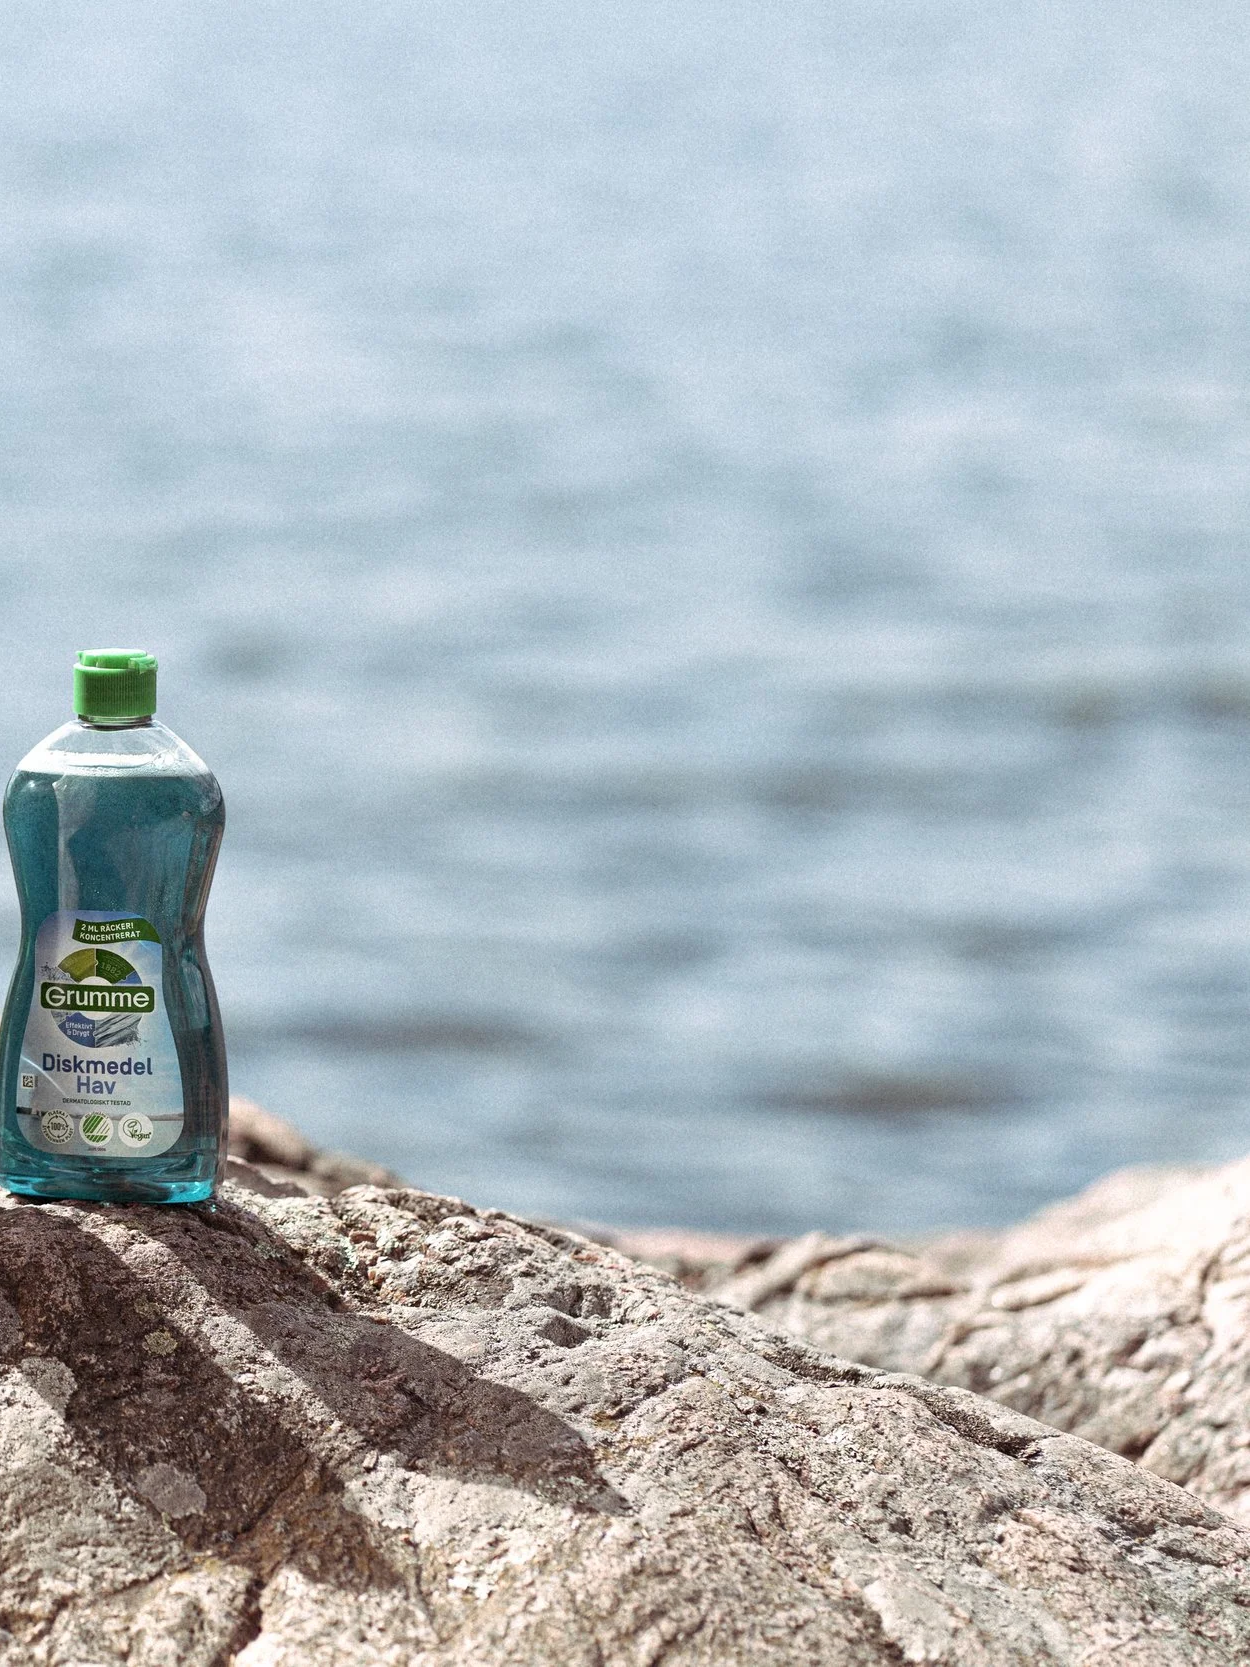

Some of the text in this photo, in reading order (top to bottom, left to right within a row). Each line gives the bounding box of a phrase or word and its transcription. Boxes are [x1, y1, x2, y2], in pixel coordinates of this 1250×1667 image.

[81, 923, 87, 931] 2
[100, 922, 134, 932] RÄCKER!
[80, 930, 141, 941] KONCENTRERAT
[100, 962, 122, 977] 1882
[45, 986, 150, 1008] Grumme
[65, 1022, 93, 1030] Effektivt
[42, 1053, 153, 1075] Diskmedel
[77, 1075, 116, 1095] Hav
[62, 1098, 110, 1106] DERMATOLOGISKT
